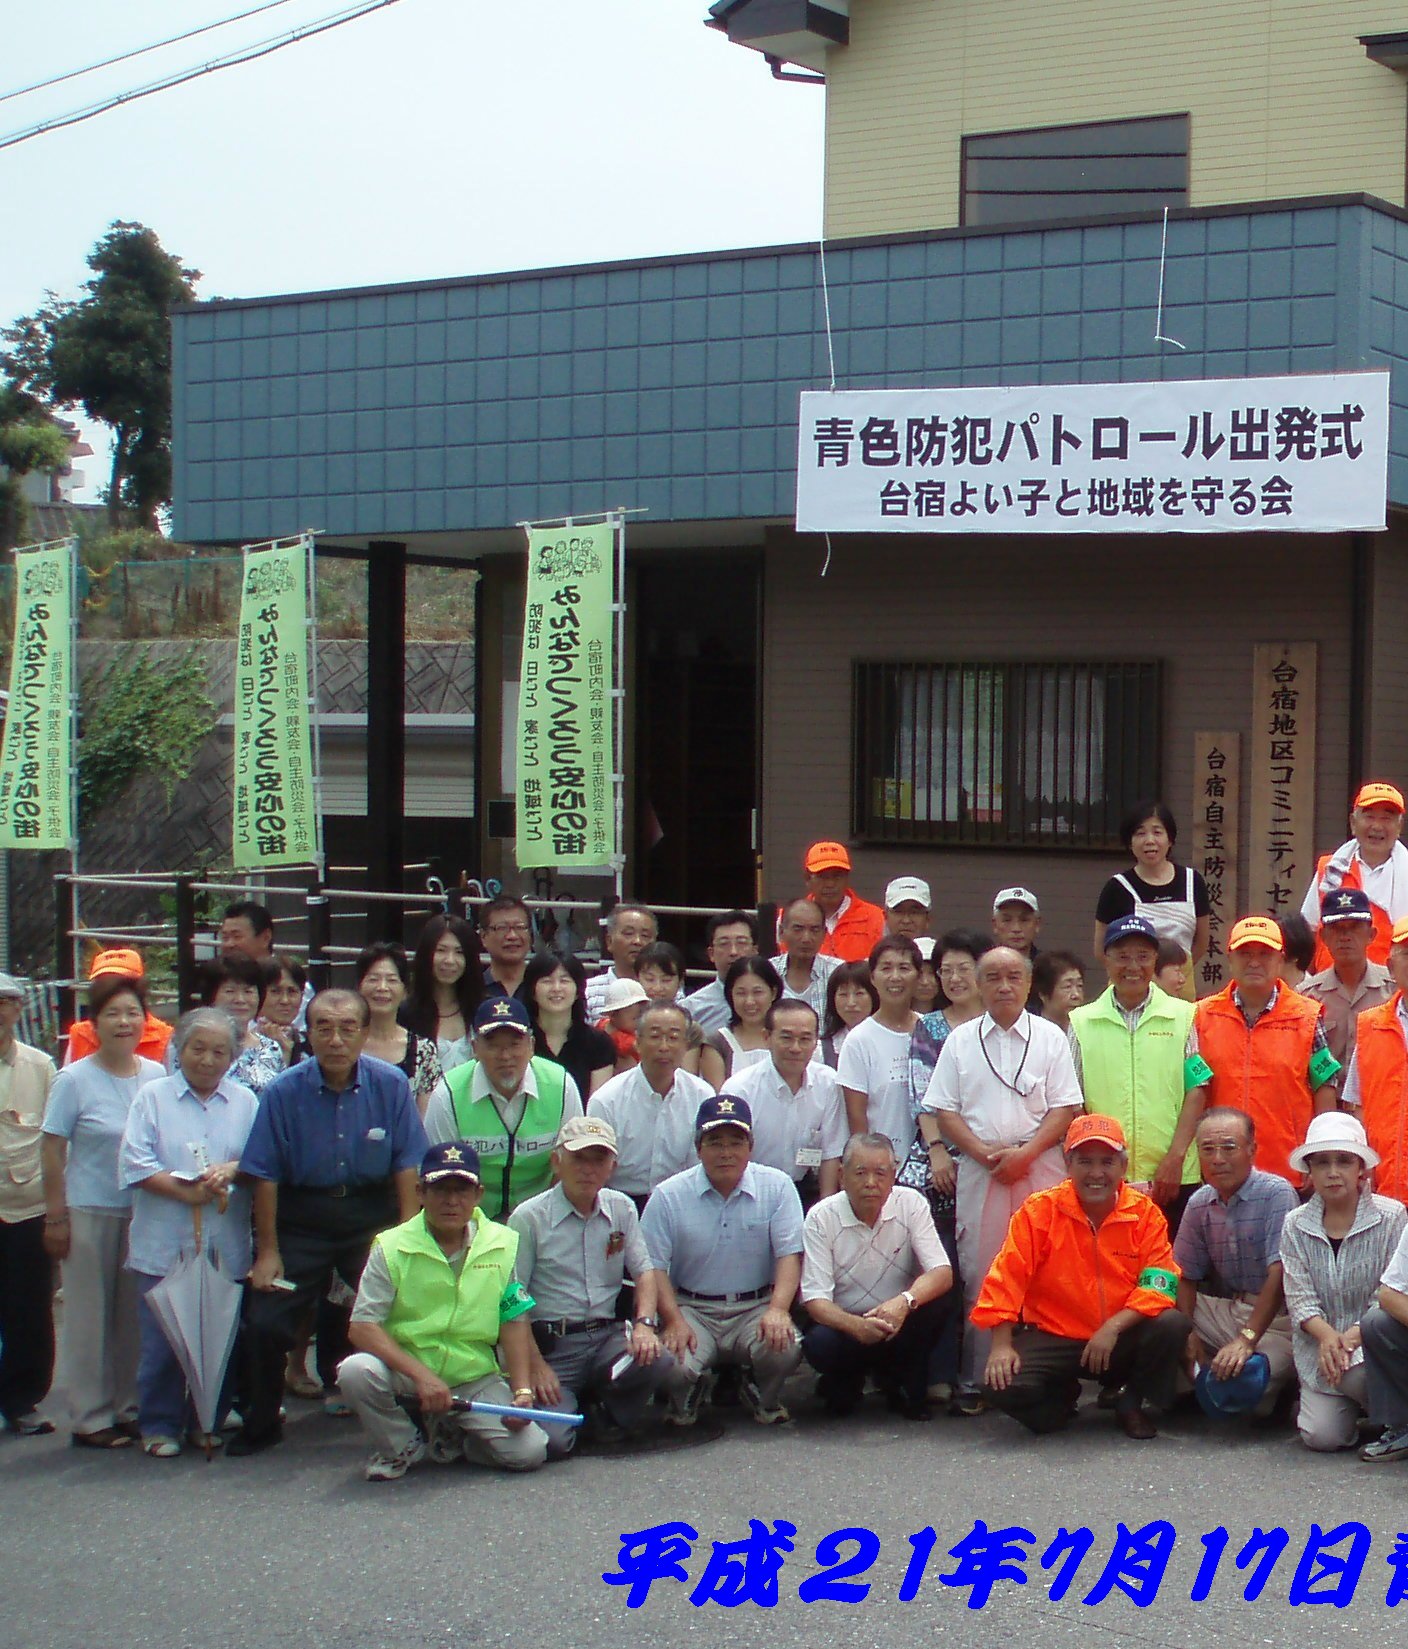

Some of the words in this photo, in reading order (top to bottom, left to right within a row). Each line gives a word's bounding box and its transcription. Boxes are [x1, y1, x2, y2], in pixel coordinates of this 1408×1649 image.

[813, 402, 1365, 468] 青色防犯パトロール出発式
[879, 475, 1294, 519] 台宿よい子と地域を守る会
[1201, 747, 1228, 985] 台宿自主防災会本部
